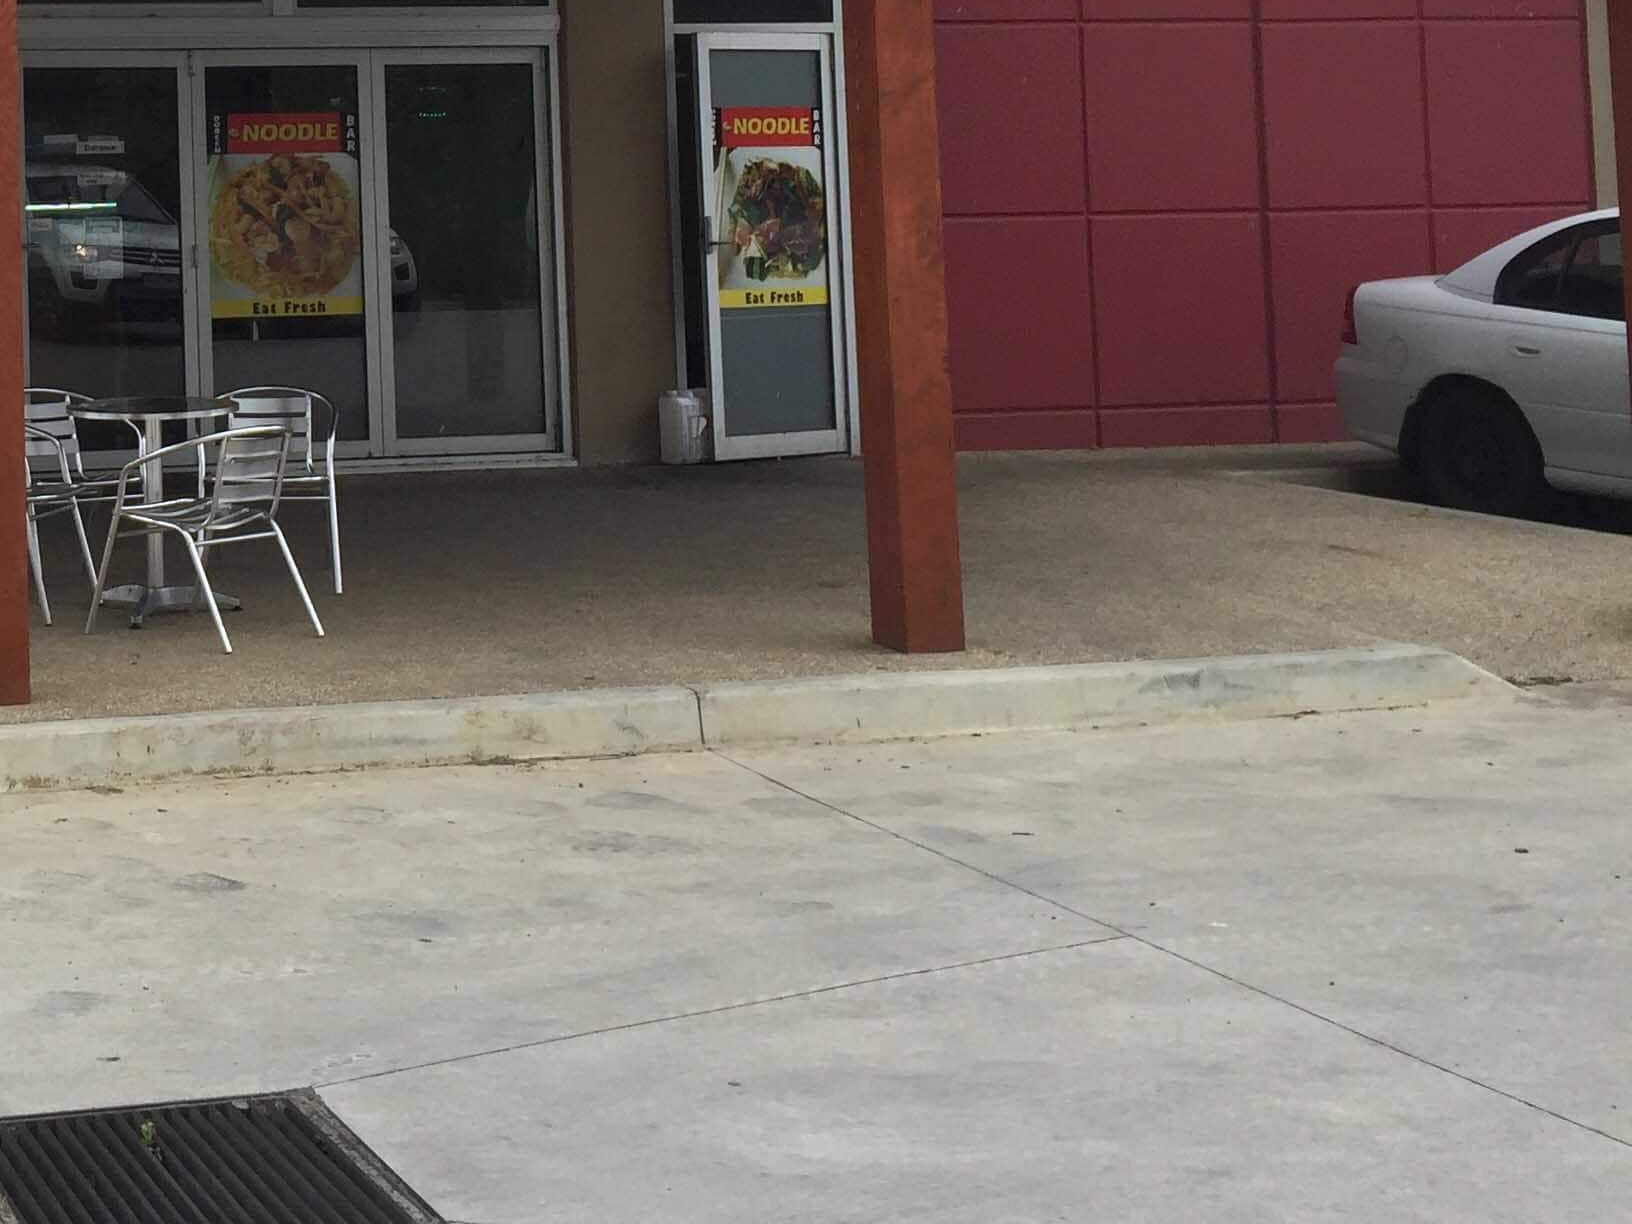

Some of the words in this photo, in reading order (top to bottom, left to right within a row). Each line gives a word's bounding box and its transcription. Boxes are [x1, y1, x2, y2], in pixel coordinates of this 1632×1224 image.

[242, 123, 338, 142] NOODLE
[346, 114, 356, 151] BAR
[733, 117, 810, 135] NOODLE
[745, 292, 764, 304] Eat
[771, 290, 803, 303] Fresh
[253, 302, 276, 314] Eat
[284, 300, 326, 313] Fresh
